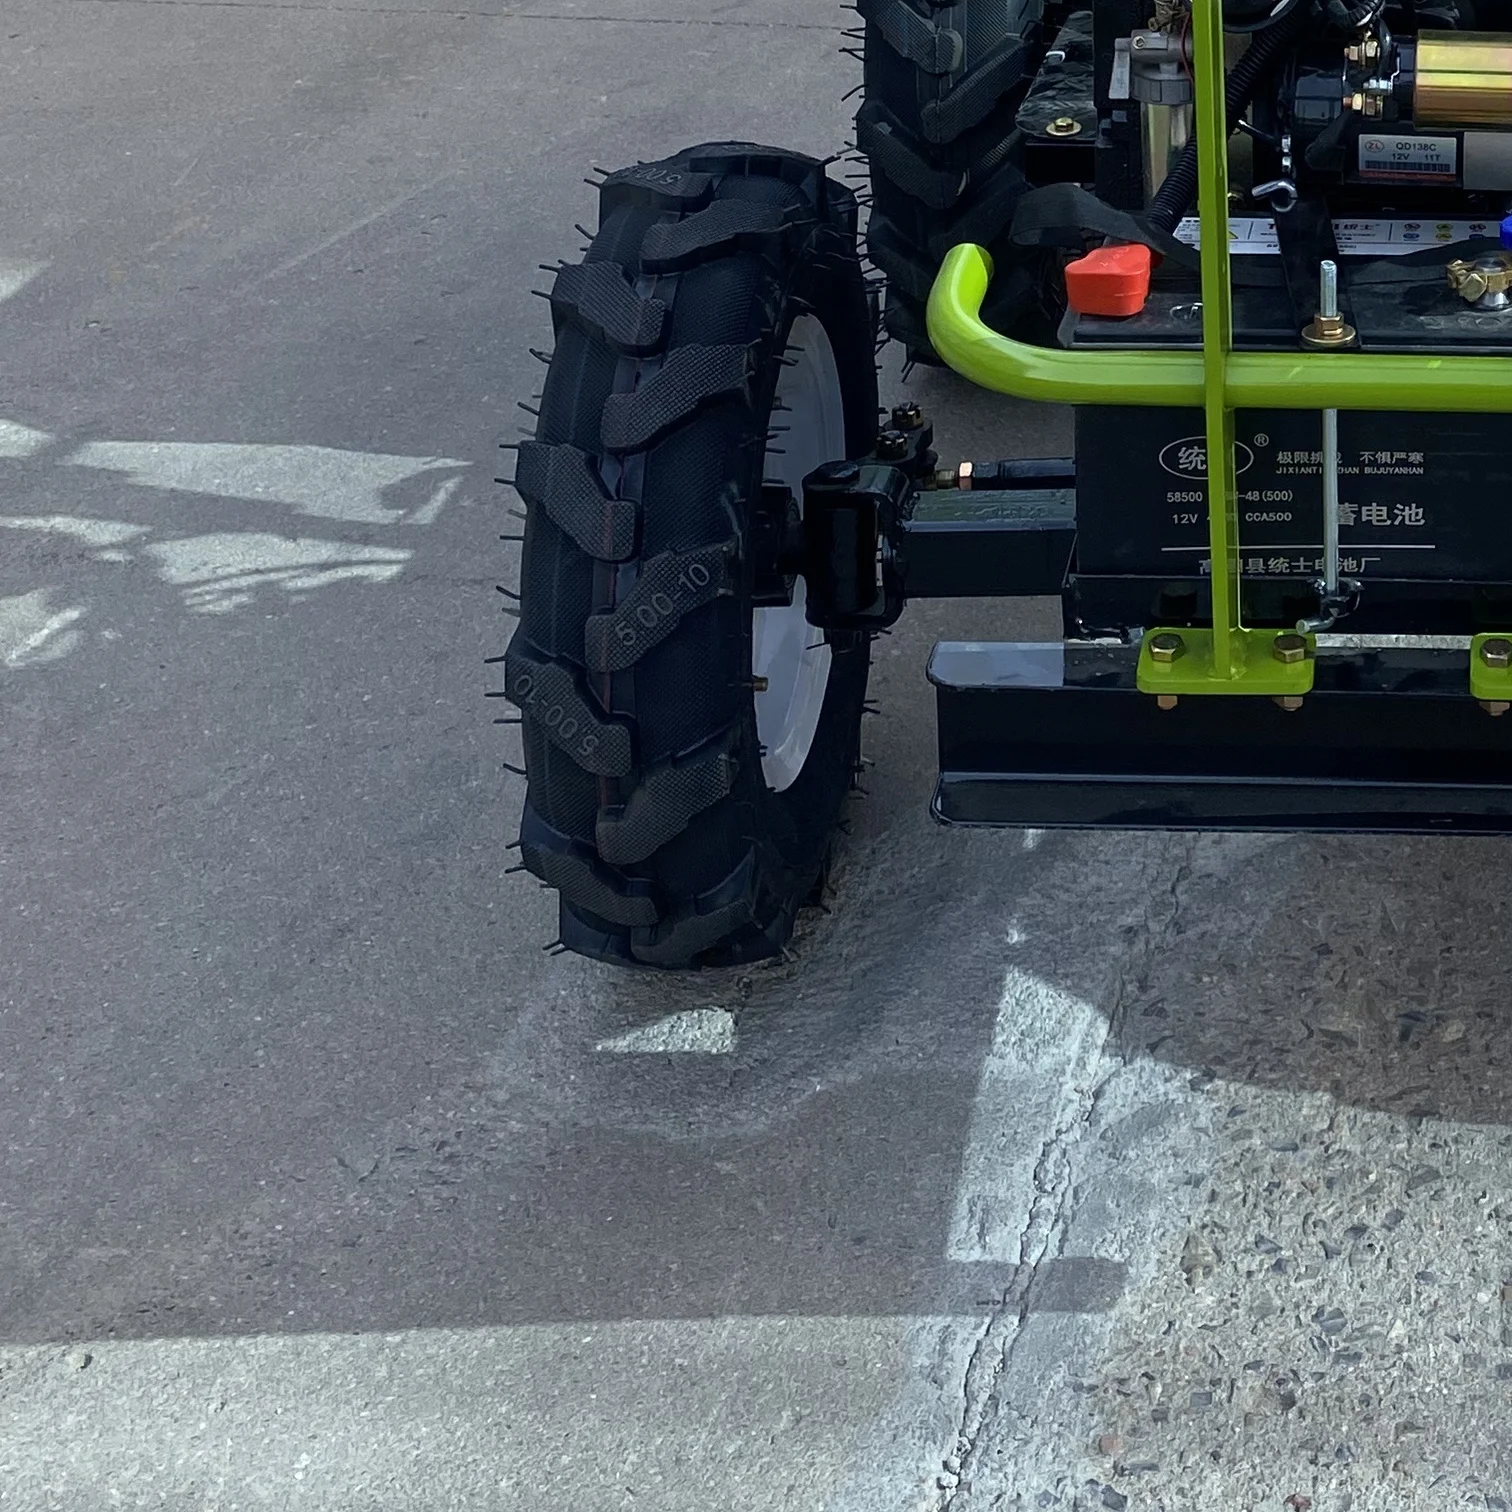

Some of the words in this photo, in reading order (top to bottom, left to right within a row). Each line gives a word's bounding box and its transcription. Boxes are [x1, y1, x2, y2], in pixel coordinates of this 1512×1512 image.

[1392, 153, 1410, 161] 12V
[1359, 451, 1424, 464] 不惧严寒
[1364, 467, 1424, 475] BUJUYANHAN
[1166, 492, 1203, 502] 58500
[1172, 514, 1198, 524] 12V
[1245, 512, 1292, 522] CCA500
